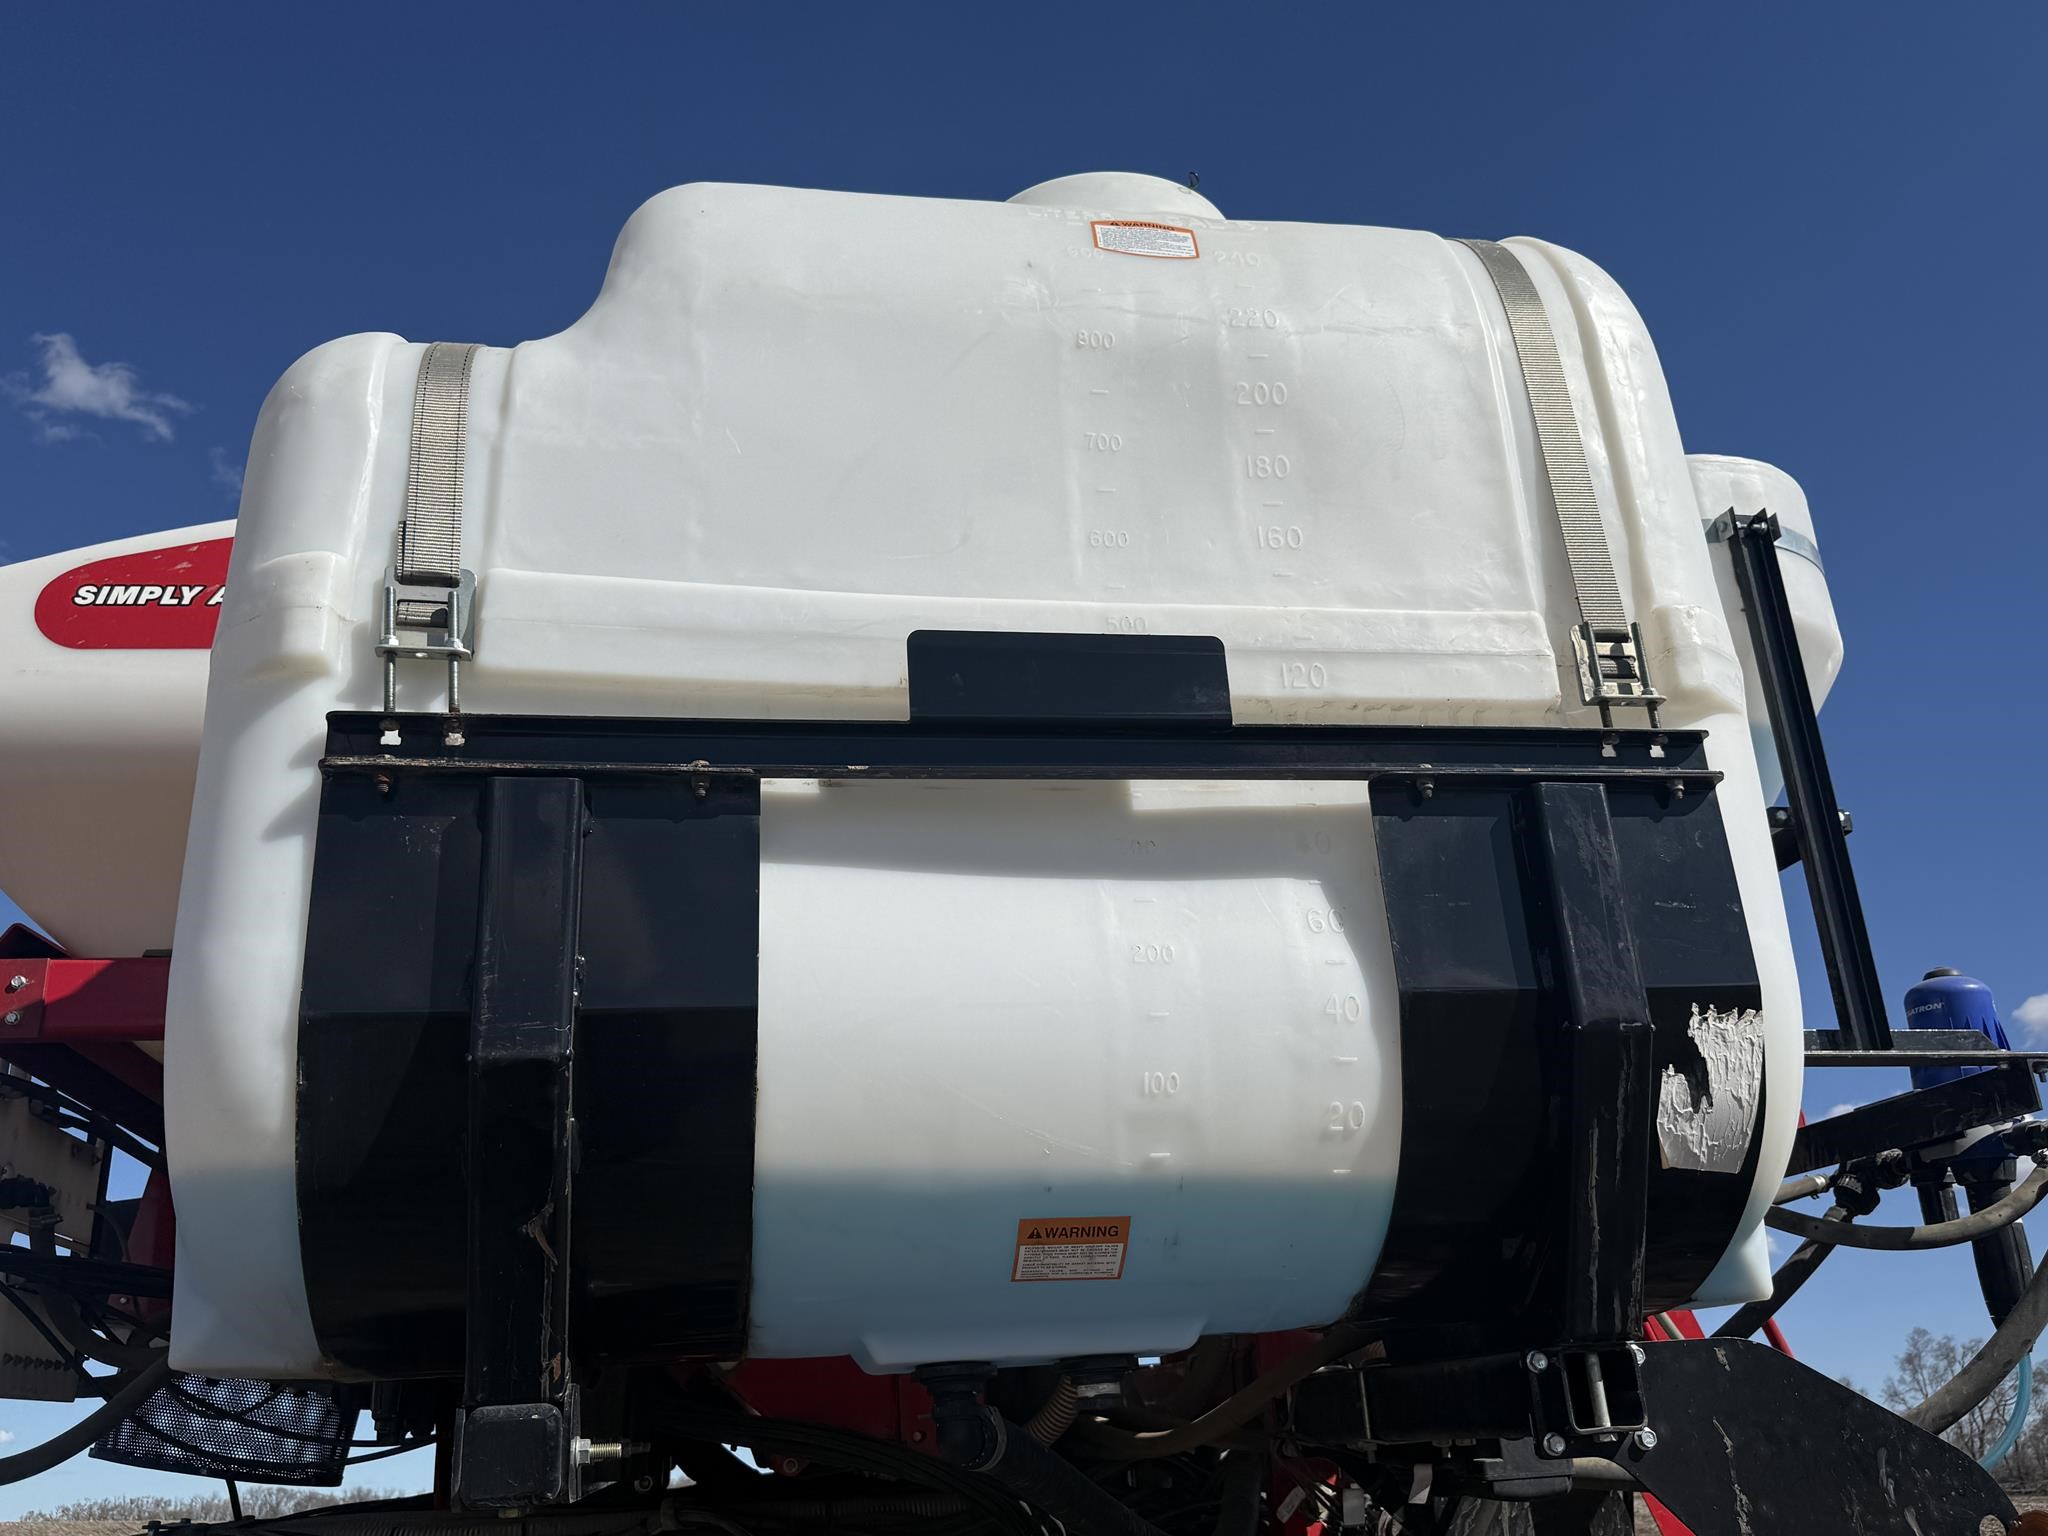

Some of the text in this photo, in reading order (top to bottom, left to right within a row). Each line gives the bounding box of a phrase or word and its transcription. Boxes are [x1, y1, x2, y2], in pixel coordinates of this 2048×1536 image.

[1122, 221, 1176, 232] WARNING
[1228, 308, 1280, 330] 220
[1076, 330, 1116, 349] 800
[1235, 382, 1288, 406] 200
[1084, 432, 1123, 451] 700
[1246, 454, 1291, 479] 180
[1089, 529, 1130, 548] 600
[1256, 525, 1304, 550] 160
[73, 584, 205, 607] SIMPLY
[1106, 616, 1149, 634] 500
[1281, 662, 1328, 688] 120
[1305, 907, 1346, 935] 60
[1132, 944, 1176, 964] 200
[1324, 993, 1362, 1022] 40
[1143, 1071, 1181, 1095] 100
[1327, 1101, 1367, 1130] 20
[1045, 1225, 1119, 1239] WARNING
